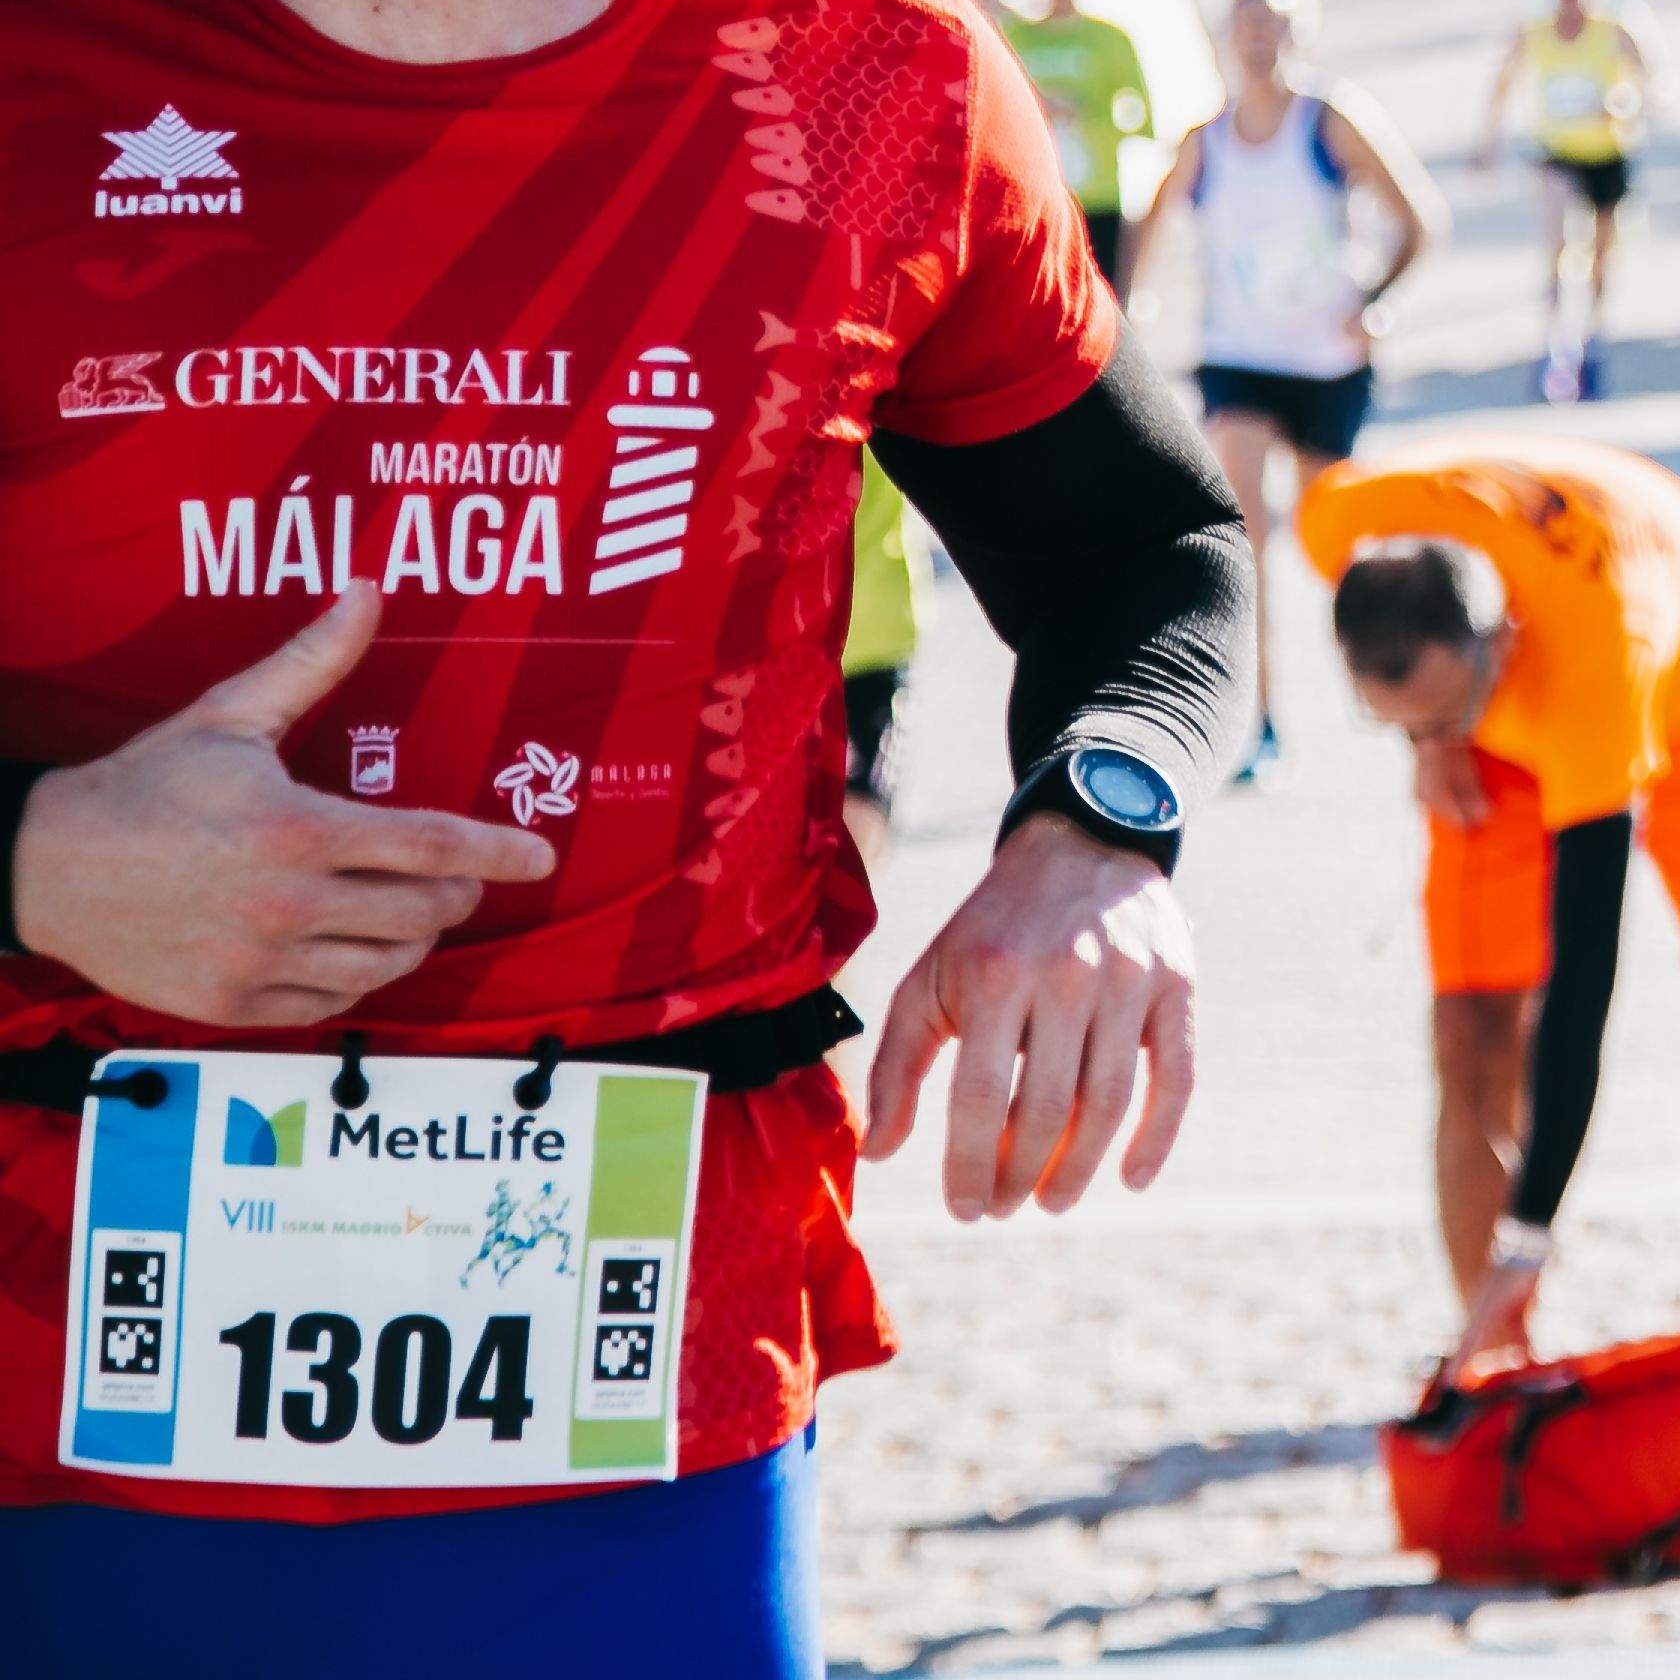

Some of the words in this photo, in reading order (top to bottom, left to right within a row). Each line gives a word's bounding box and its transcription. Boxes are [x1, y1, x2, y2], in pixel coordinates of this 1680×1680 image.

[94, 188, 243, 218] luanvi
[174, 345, 572, 408] GENERALI
[370, 435, 562, 487] MARATÓN
[179, 474, 564, 597] MÁLAGA
[328, 1113, 566, 1164] MetLife
[220, 1197, 276, 1234] VIII
[219, 1311, 535, 1446] 1304
